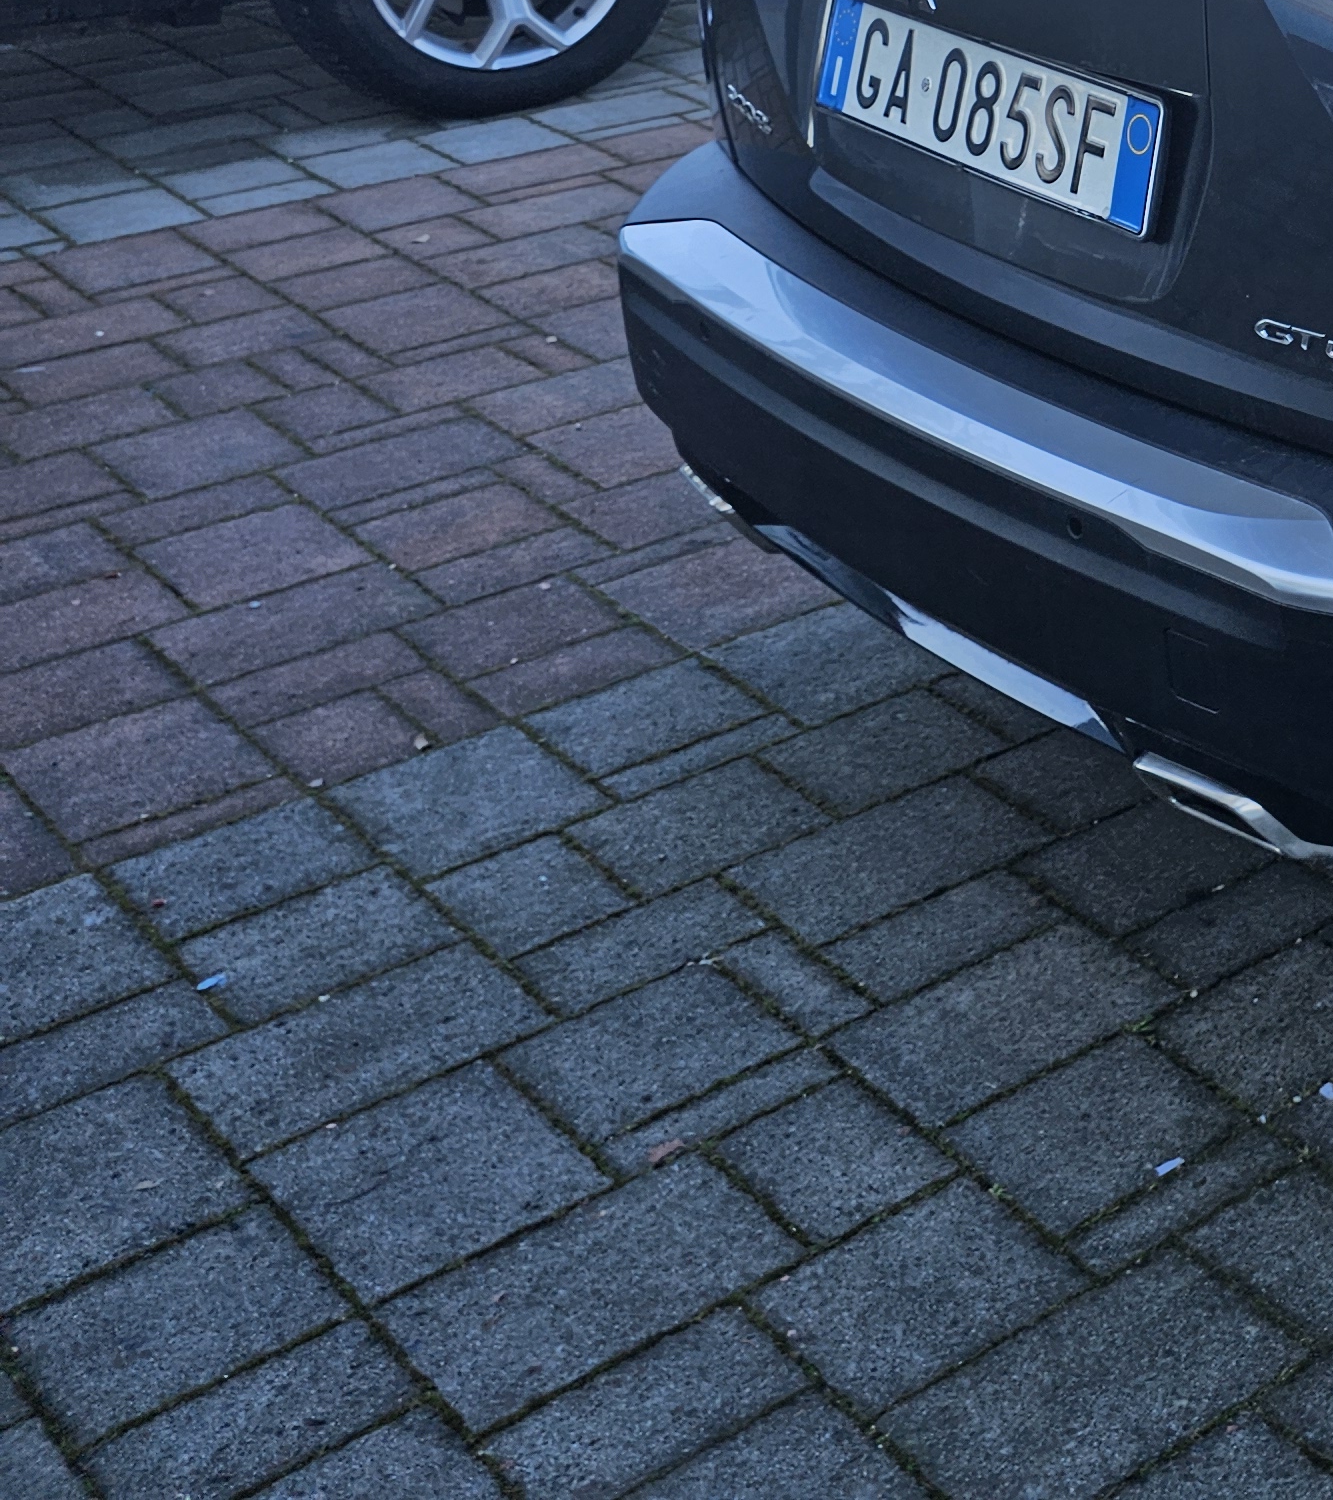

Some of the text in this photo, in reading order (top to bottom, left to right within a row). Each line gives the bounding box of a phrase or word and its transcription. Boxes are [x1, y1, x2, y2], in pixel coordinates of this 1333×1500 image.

[855, 18, 915, 125] GA
[932, 48, 1117, 195] 085SF
[1254, 318, 1326, 350] GT
